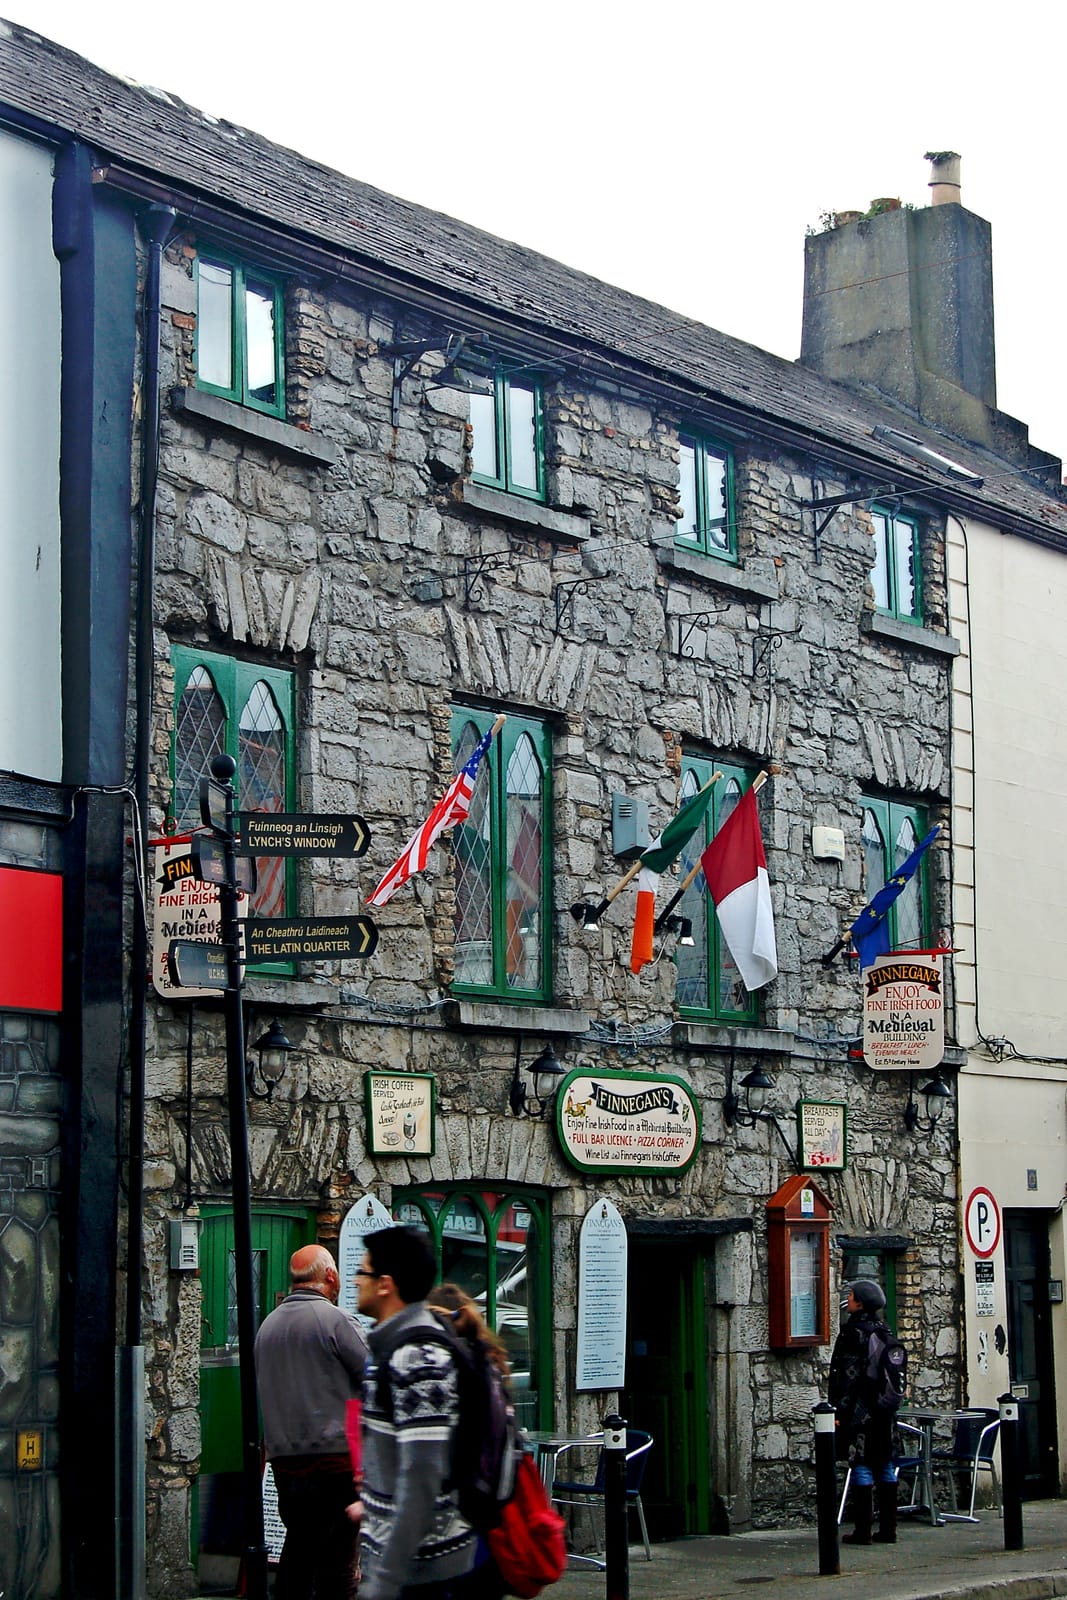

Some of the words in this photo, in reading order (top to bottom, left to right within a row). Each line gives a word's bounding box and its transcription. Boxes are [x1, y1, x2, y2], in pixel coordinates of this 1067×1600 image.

[248, 820, 293, 834] Fuinneog
[295, 824, 307, 833] an
[309, 821, 343, 834] Linsigh
[248, 836, 292, 848] LYNCH'S
[293, 837, 336, 849] WINDOW
[181, 880, 217, 893] ENJO
[159, 894, 185, 907] FINE
[188, 893, 217, 906] IRISH
[181, 909, 194, 920] IN
[198, 908, 208, 919] A
[162, 920, 223, 938] Medieva
[251, 927, 263, 938] An
[266, 926, 304, 938] Cheathrú
[252, 943, 272, 955] THE
[273, 943, 300, 954] LATIN
[303, 941, 350, 953] QUARTER
[871, 966, 938, 984] FINNEGAN'S
[885, 985, 925, 1000] ENJOY
[867, 1000, 887, 1011] FINE
[890, 1000, 914, 1010] IRISH
[915, 999, 941, 1010] FOOD
[889, 1012, 900, 1020] IN
[903, 1012, 912, 1020] A
[869, 1018, 936, 1033] Medieval
[883, 1033, 926, 1042] BUILDING
[372, 1080, 390, 1090] IRISH
[391, 1081, 415, 1091] COFFEE
[372, 1090, 395, 1099] SERVED
[599, 1089, 671, 1113] FINNEGAN'S
[567, 1115, 585, 1131] Enjoy
[585, 1115, 598, 1129] Fine
[598, 1116, 611, 1131] Irish
[610, 1117, 627, 1131] Food
[628, 1119, 635, 1131] in
[636, 1122, 641, 1132] a
[666, 1121, 692, 1137] Building
[572, 1133, 588, 1145] FULL
[591, 1134, 604, 1145] BAR
[607, 1135, 633, 1147] LICENCE
[637, 1137, 656, 1148] PIZZA
[656, 1138, 685, 1149] CORNER
[585, 1149, 601, 1160] Wine
[601, 1149, 610, 1160] List
[662, 1152, 681, 1163] Coffee
[977, 1201, 989, 1244] P
[27, 1440, 35, 1456] H
